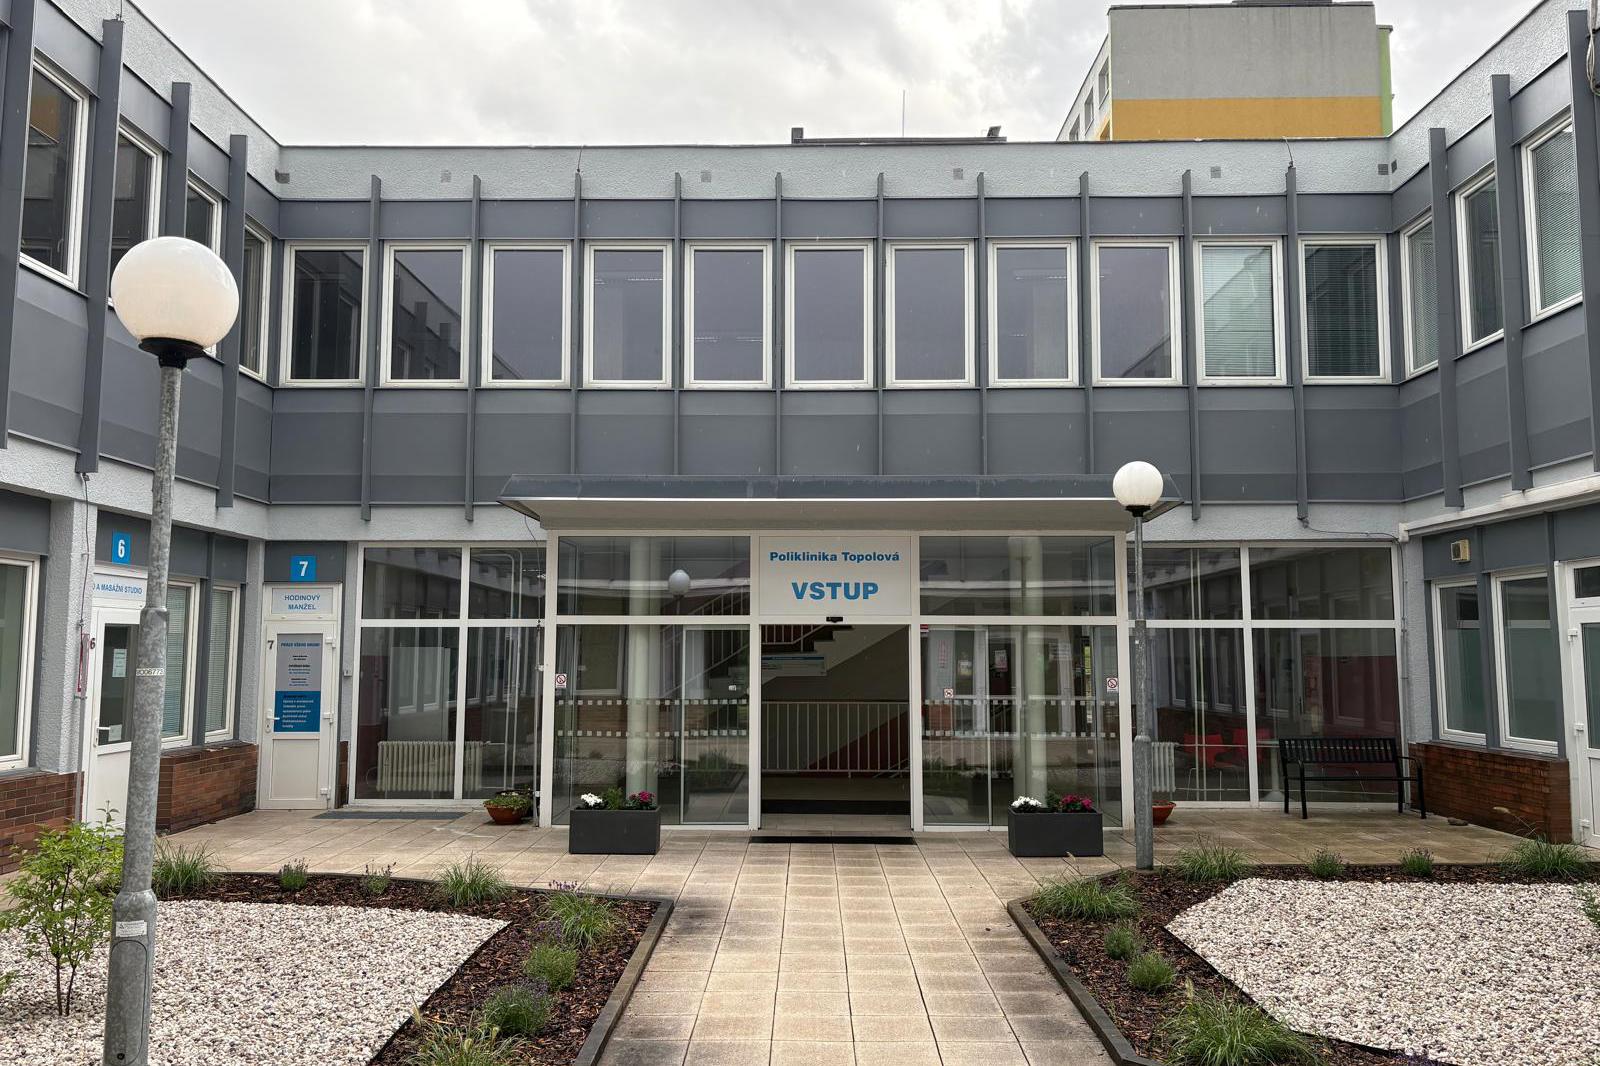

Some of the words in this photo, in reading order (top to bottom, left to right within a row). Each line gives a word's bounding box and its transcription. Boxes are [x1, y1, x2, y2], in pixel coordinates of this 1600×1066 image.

[117, 539, 126, 558] 6
[769, 551, 838, 562] Poliklinika
[841, 551, 900, 563] Topolová
[299, 561, 308, 577] 7
[125, 586, 143, 594] STUDIO
[791, 581, 879, 600] VSTUP
[284, 593, 321, 601] HODINOVÝ
[288, 602, 317, 610] MANŽEL
[89, 637, 96, 650] 6
[267, 640, 274, 650] 7
